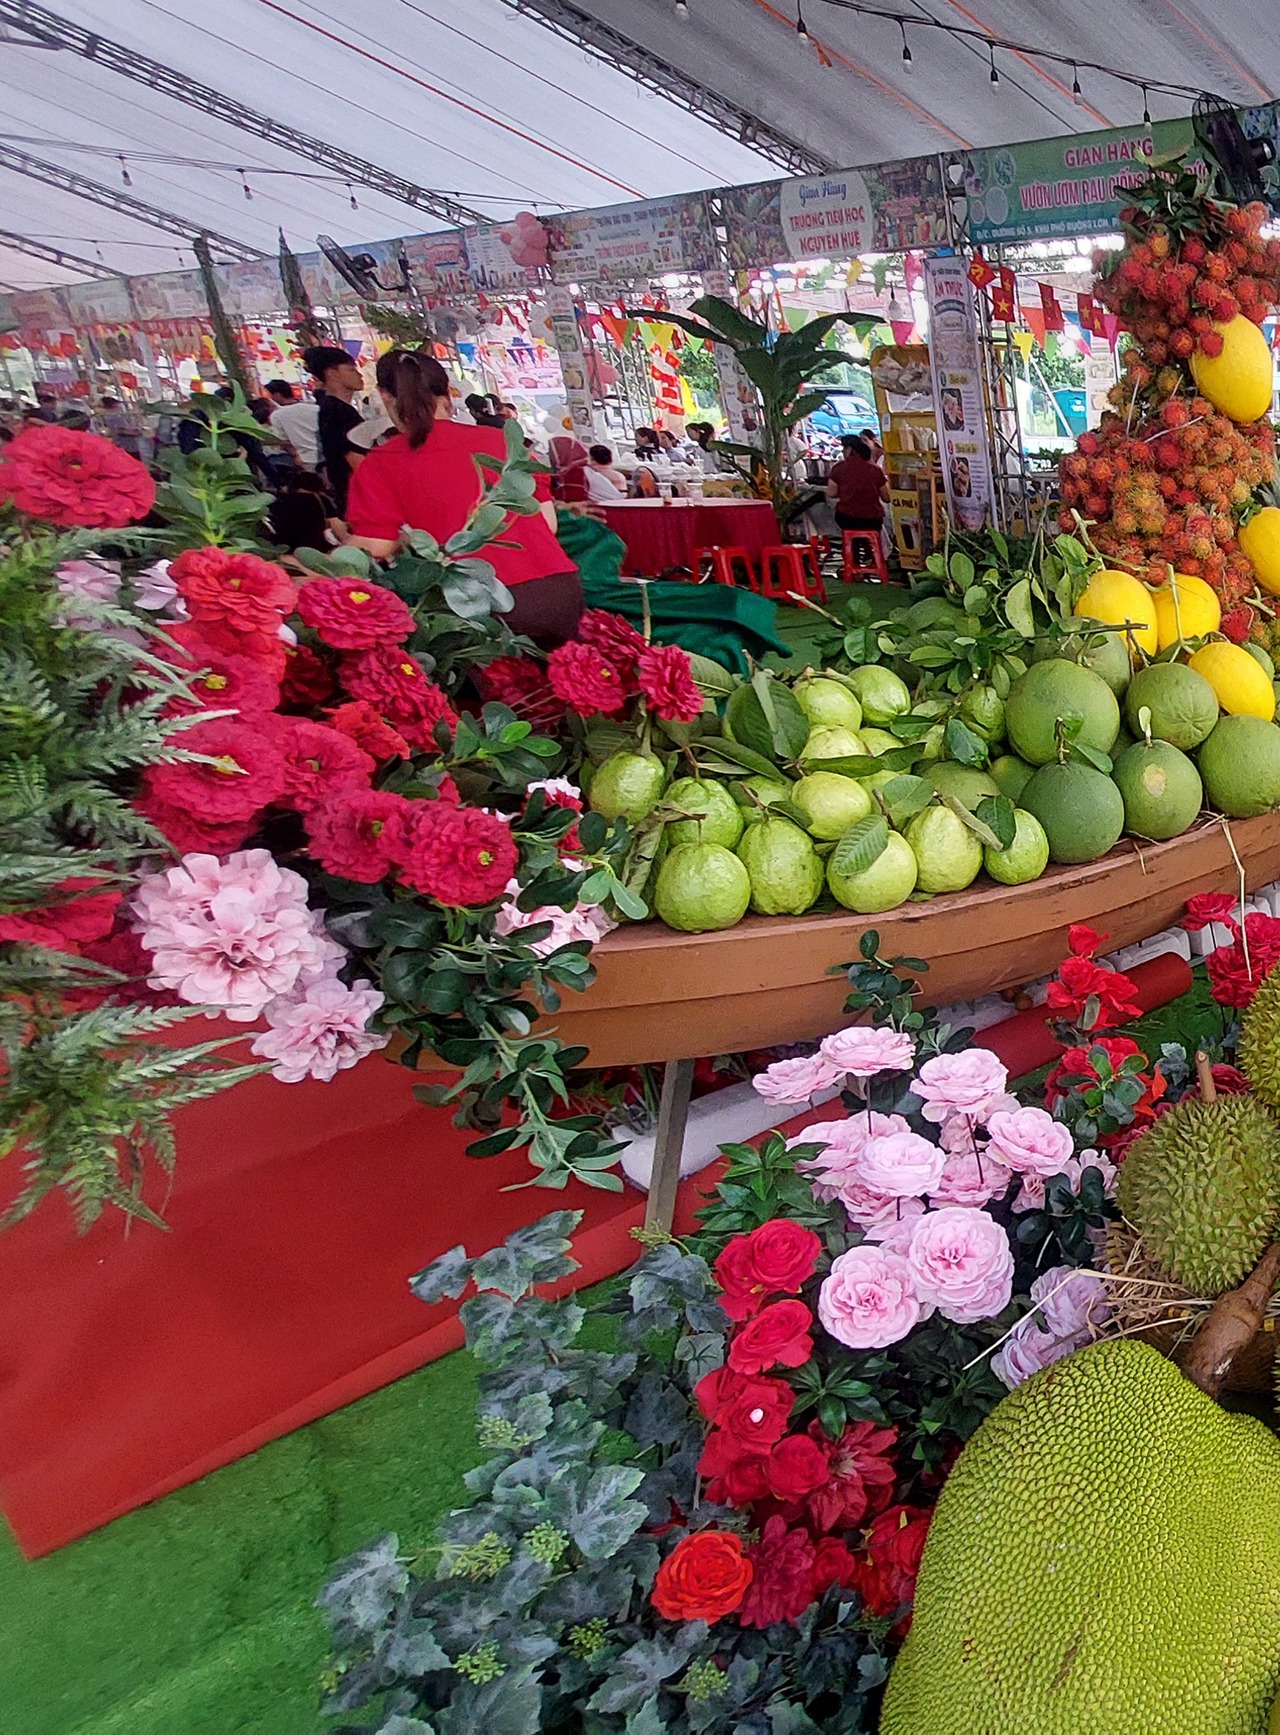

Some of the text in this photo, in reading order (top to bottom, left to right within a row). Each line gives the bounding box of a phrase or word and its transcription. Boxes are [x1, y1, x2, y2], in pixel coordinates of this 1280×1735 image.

[1064, 138, 1153, 168] GIAN HÀNG
[1083, 177, 1105, 204] RAU
